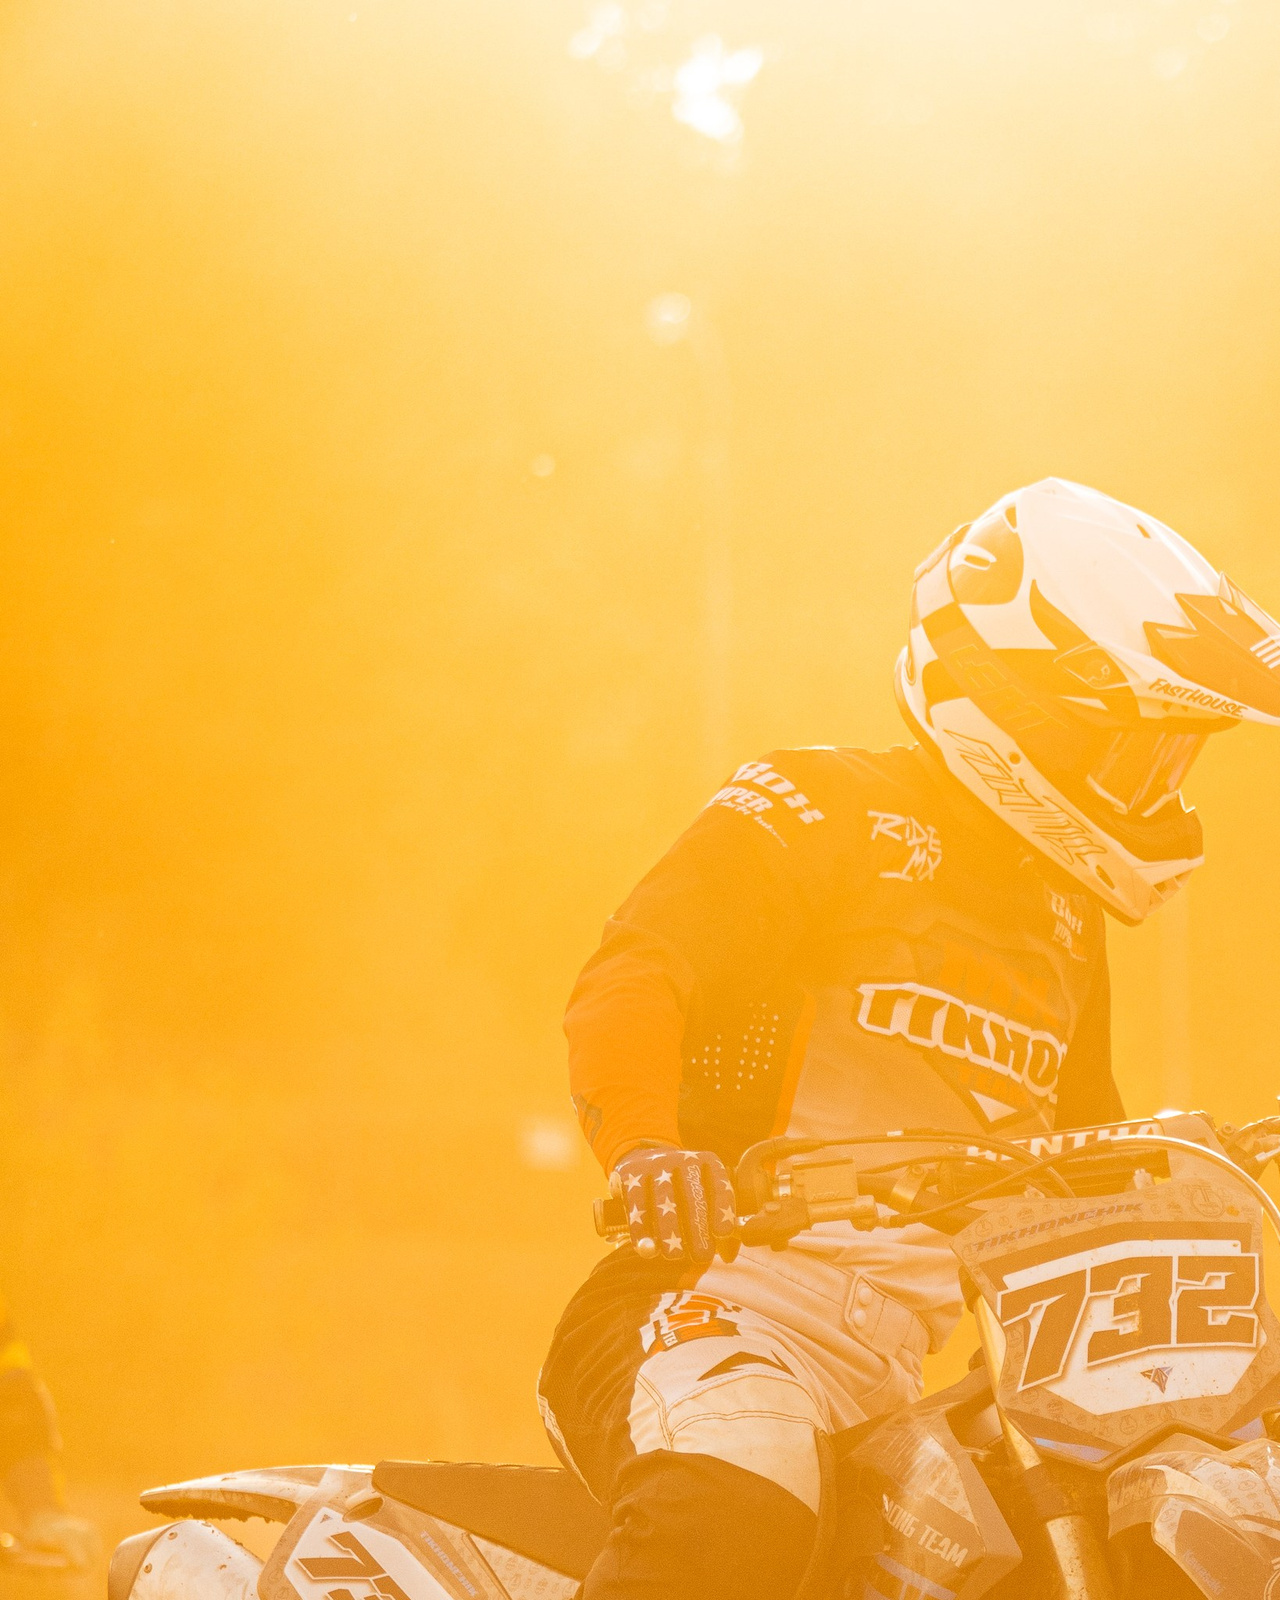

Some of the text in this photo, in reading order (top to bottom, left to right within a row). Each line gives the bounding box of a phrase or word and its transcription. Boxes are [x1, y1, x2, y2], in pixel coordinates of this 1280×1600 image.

[972, 1202, 1144, 1252] TIKHONCHIK
[998, 1254, 1260, 1393] 732
[917, 1523, 969, 1568] TEAM
